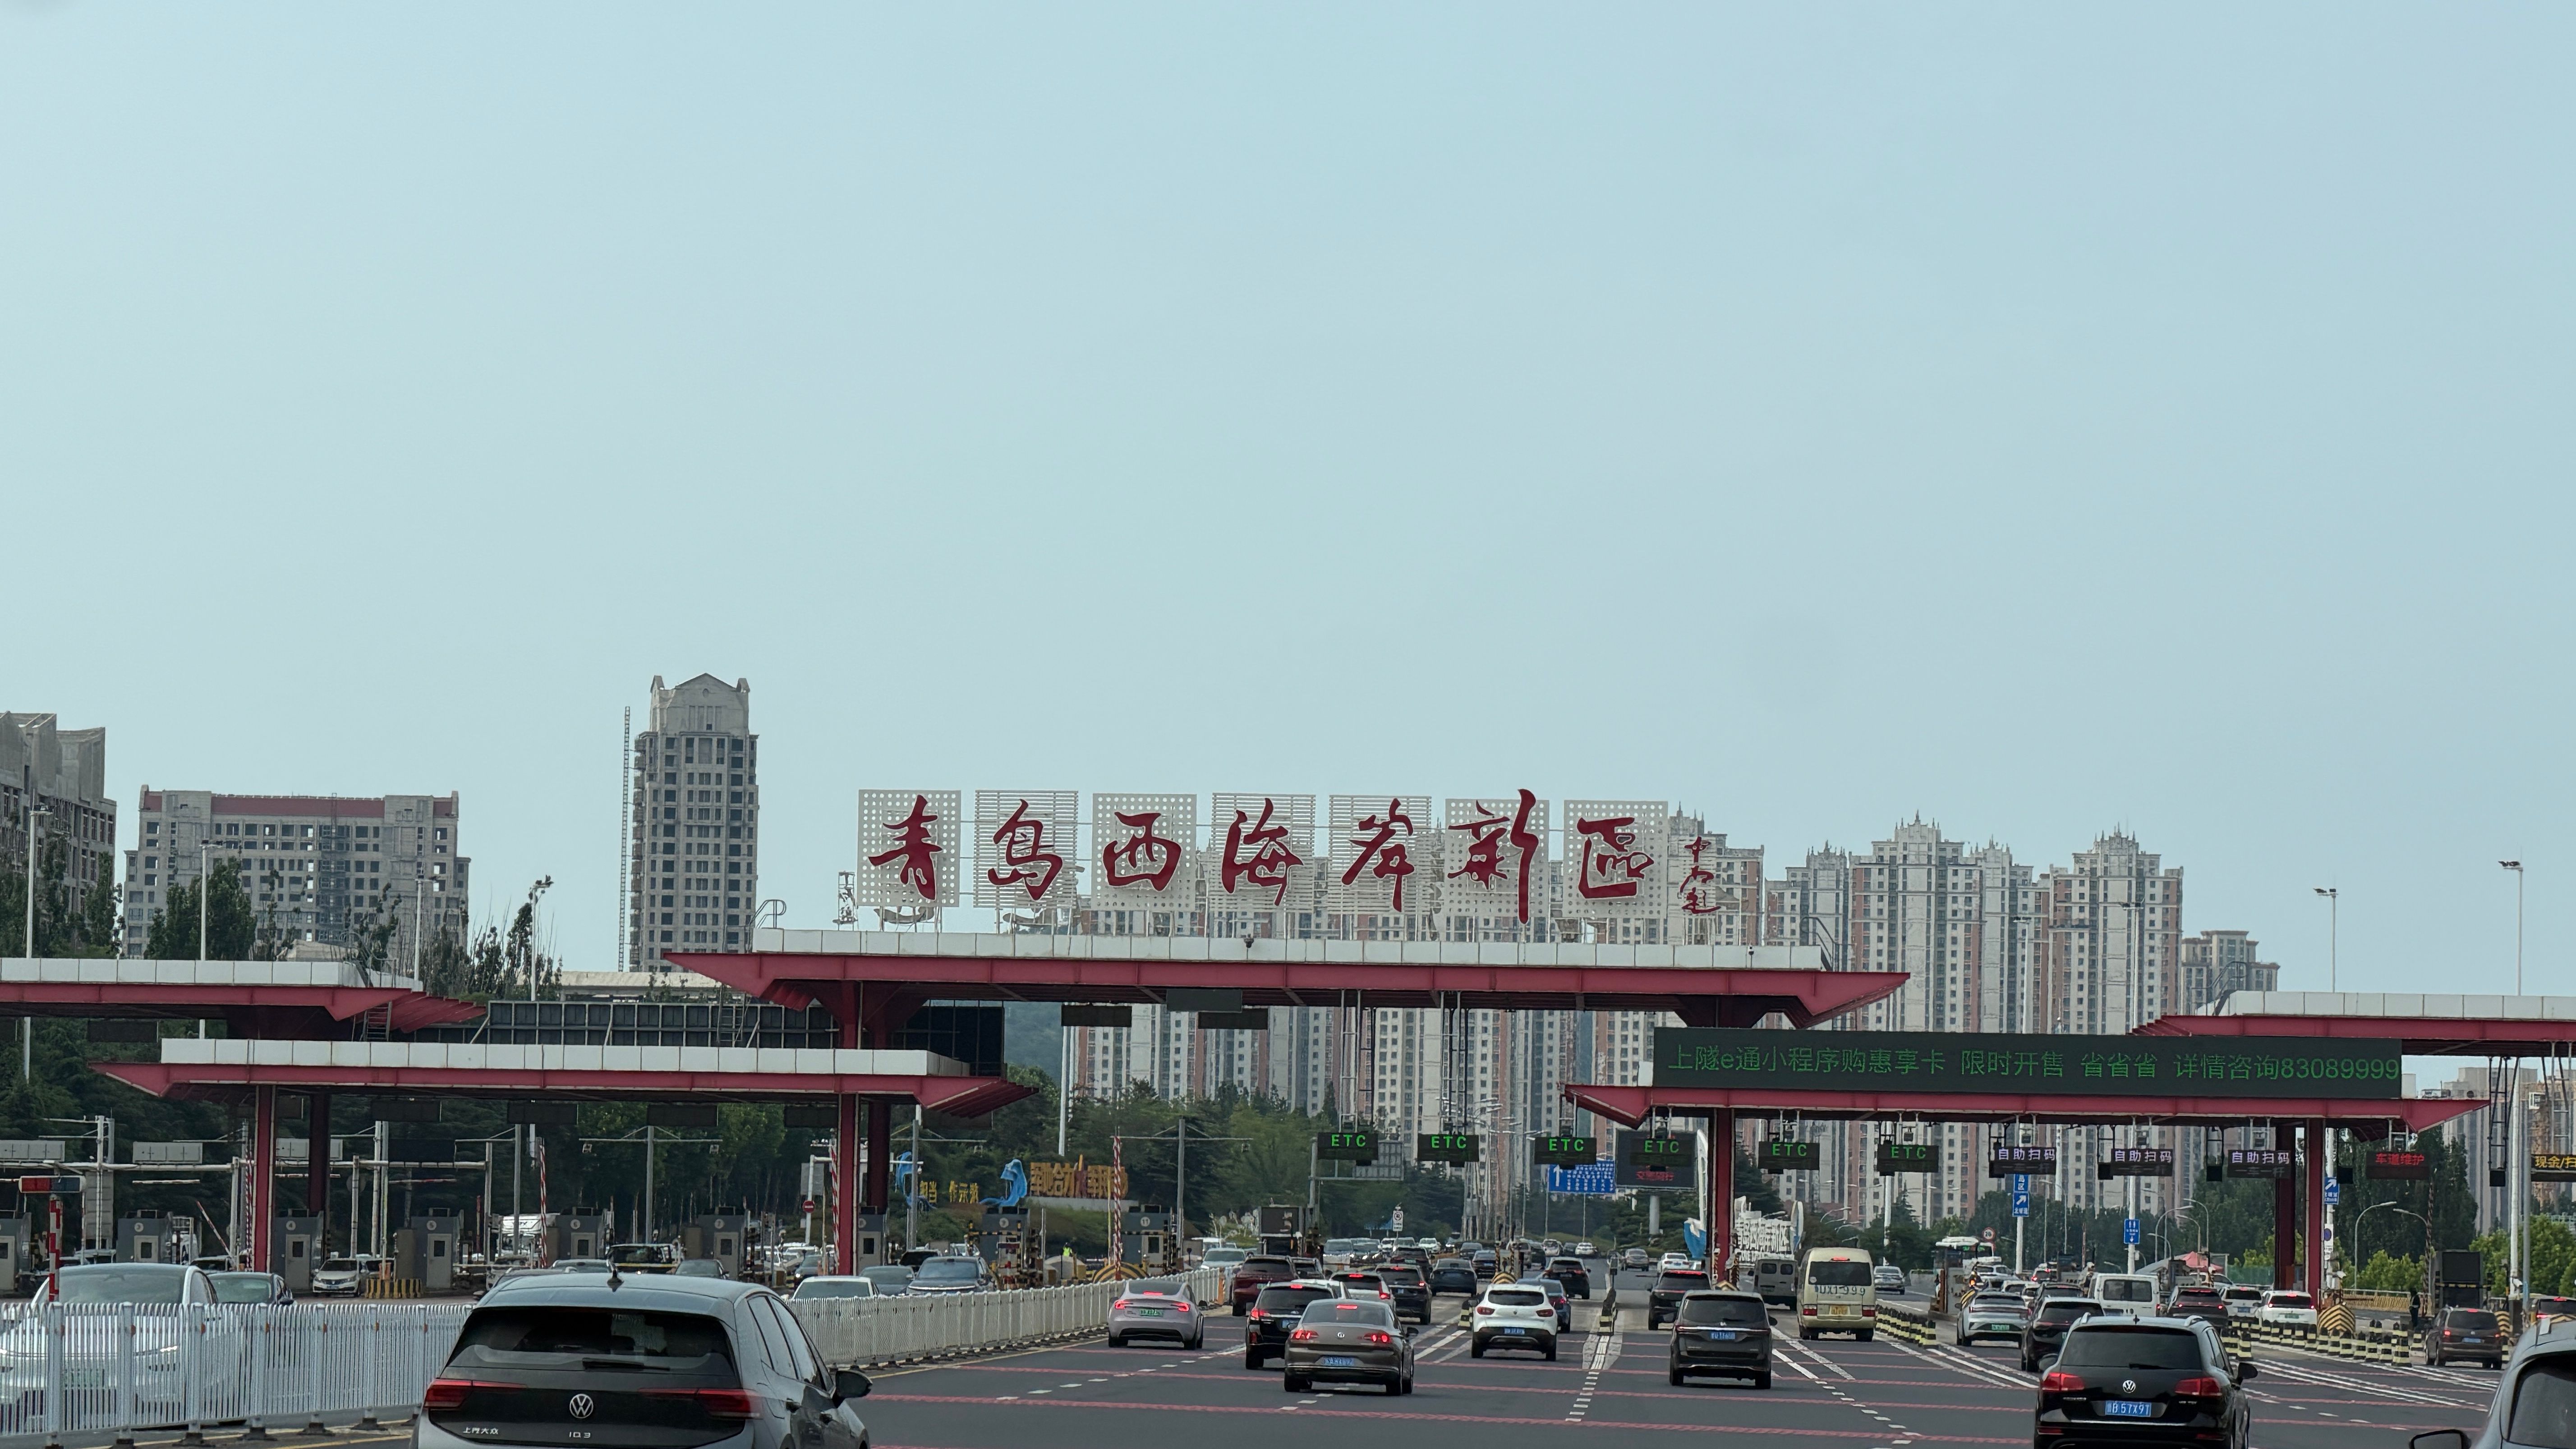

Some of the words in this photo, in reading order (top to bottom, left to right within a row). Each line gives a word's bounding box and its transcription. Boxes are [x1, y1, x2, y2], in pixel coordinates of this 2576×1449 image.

[1668, 1044, 1946, 1075] 上隧e通小程序购惠享卡
[1961, 1050, 2064, 1077] 限时开售
[2080, 1051, 2158, 1078] 省省省
[2173, 1053, 2399, 1080] 详情咨询83089999
[1331, 1134, 1366, 1147] ETC
[1431, 1136, 1467, 1149] ETC
[1549, 1138, 1584, 1151] ETC
[1644, 1140, 1679, 1153] ETC
[1772, 1144, 1807, 1156] ETC
[1891, 1146, 1927, 1159] ETC
[1998, 1148, 2055, 1161] 自助扫码
[2115, 1150, 2172, 1163] 自助扫码
[2232, 1151, 2290, 1164] 自助扫码
[463, 1427, 499, 1435] 上汽大众
